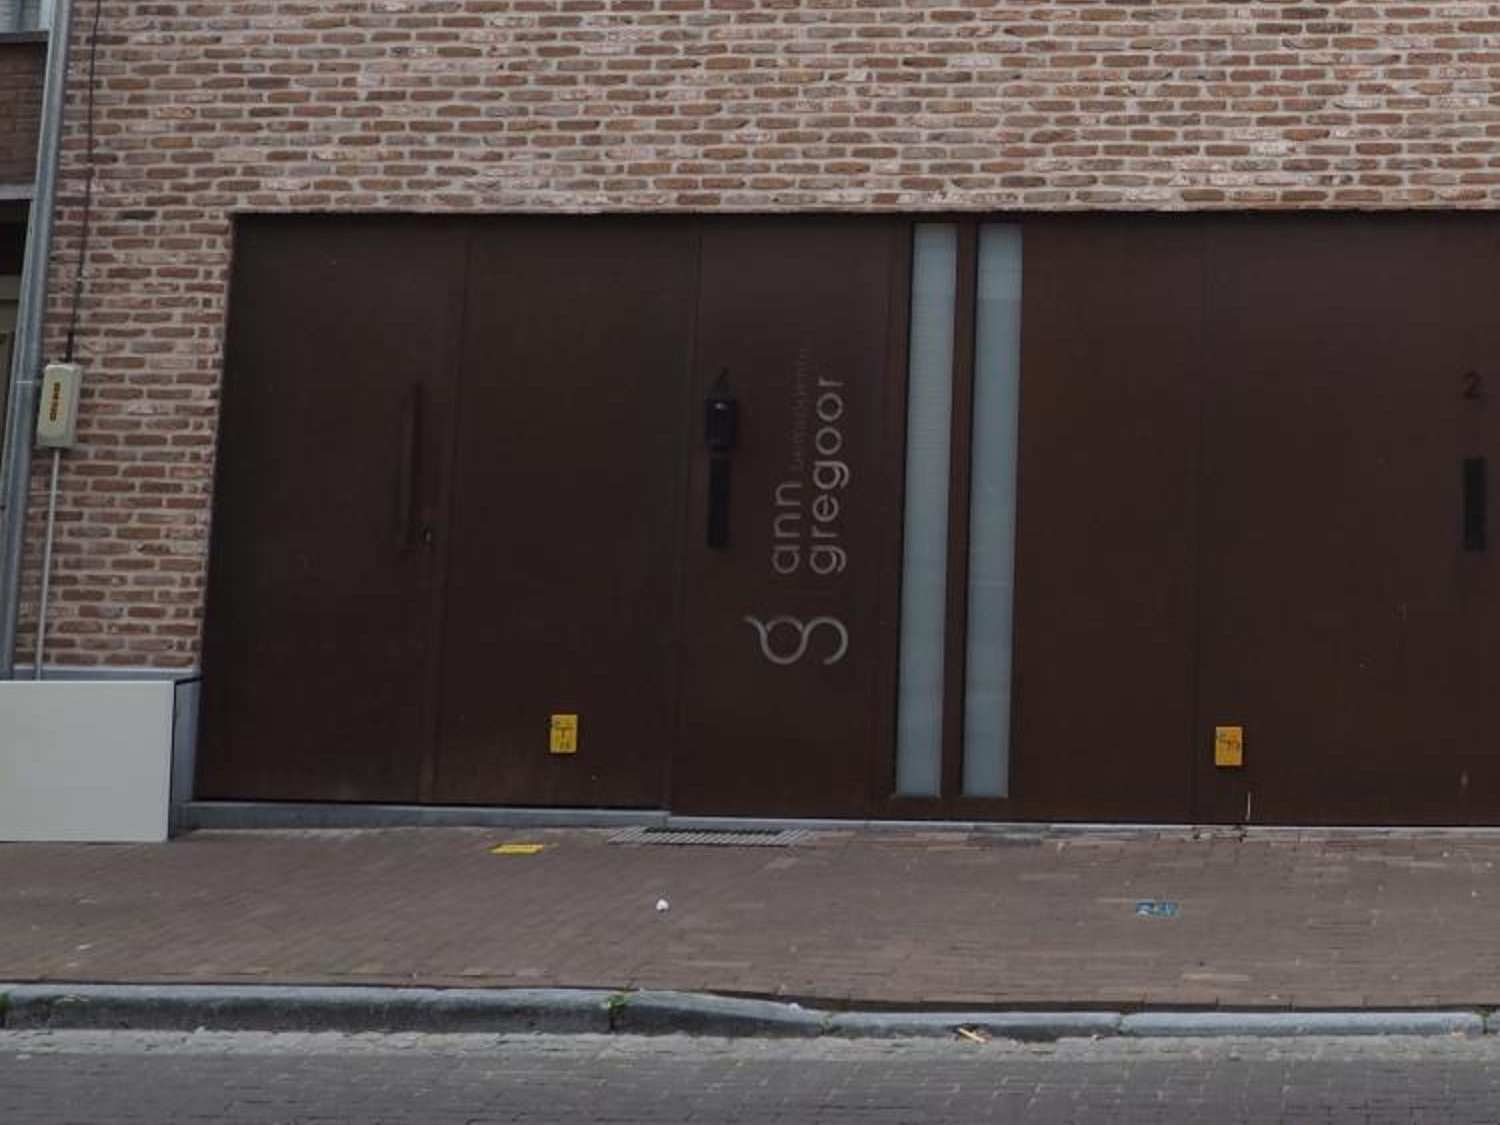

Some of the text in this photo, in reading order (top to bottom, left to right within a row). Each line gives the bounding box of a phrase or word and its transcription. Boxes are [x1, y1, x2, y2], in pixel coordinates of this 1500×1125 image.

[1461, 370, 1482, 399] 2
[809, 376, 850, 574] gregoor
[772, 482, 801, 574] ann
